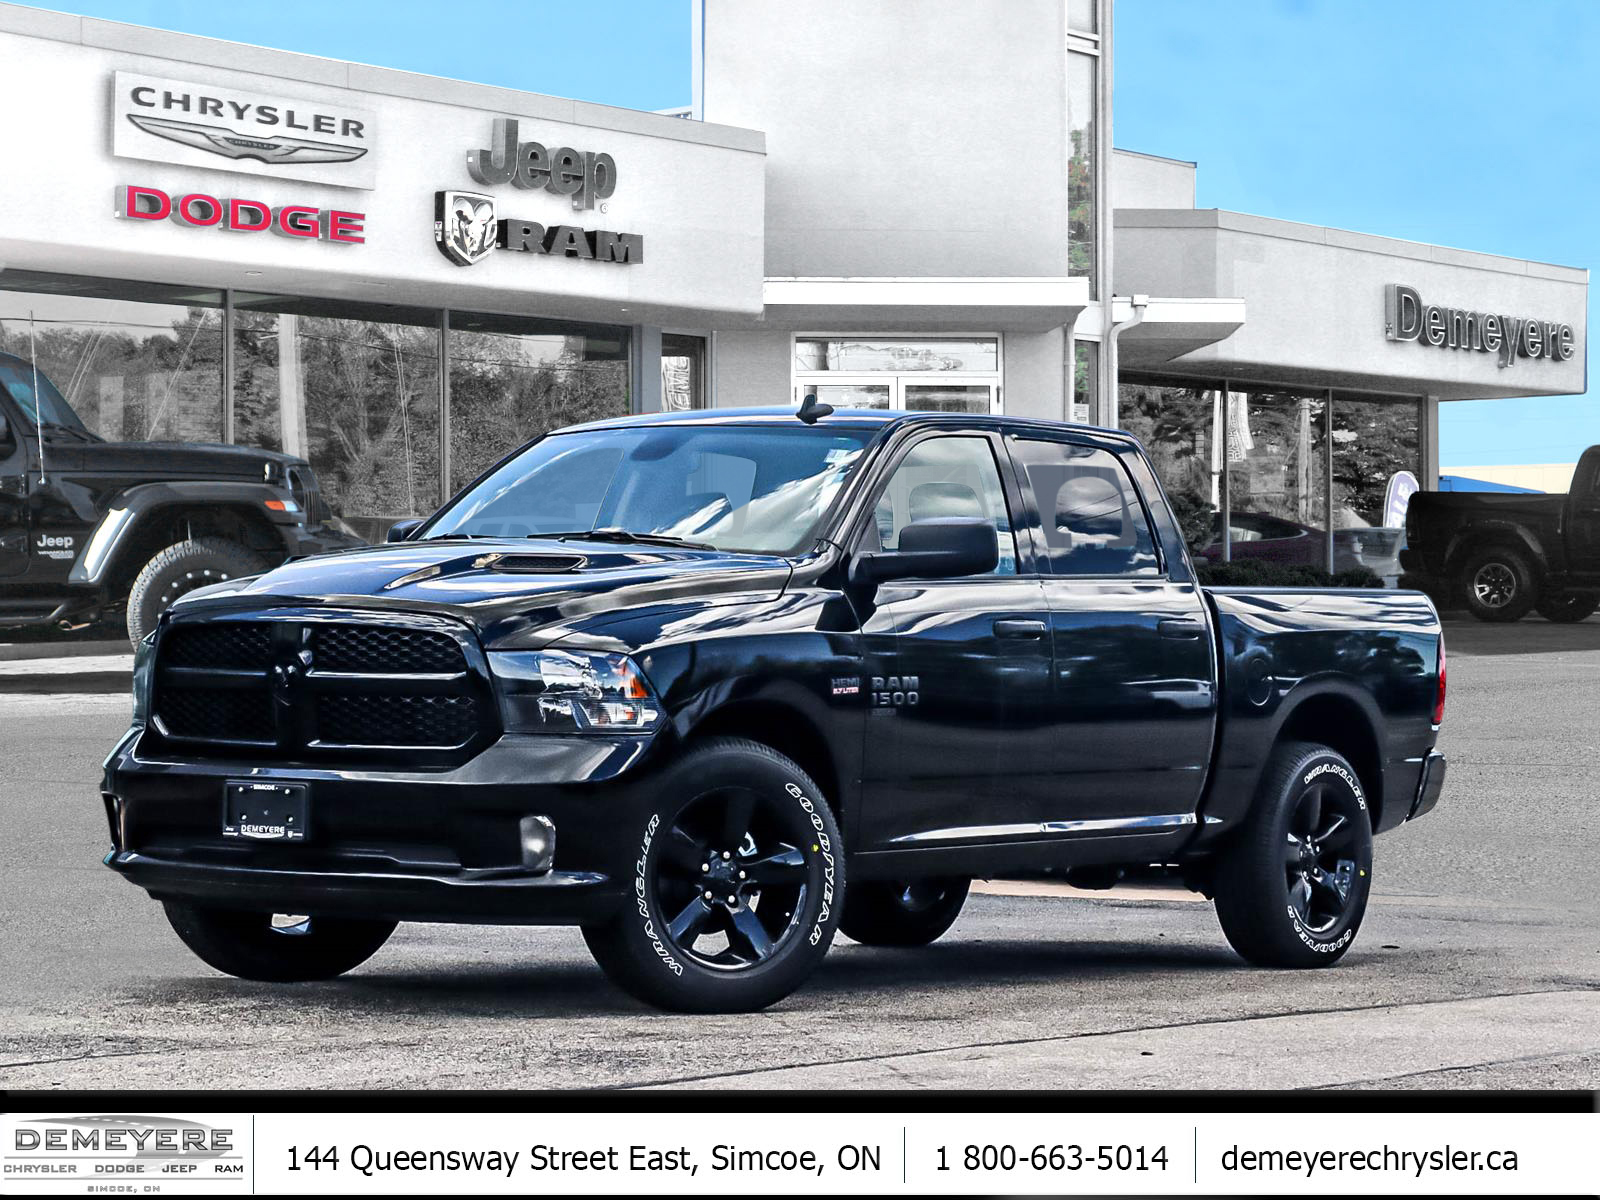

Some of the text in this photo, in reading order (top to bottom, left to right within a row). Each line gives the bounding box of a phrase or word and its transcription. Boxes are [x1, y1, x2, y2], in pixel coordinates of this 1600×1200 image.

[129, 86, 365, 140] CHRYSLER
[467, 118, 617, 210] Jeep
[115, 184, 366, 244] DODGE
[498, 218, 644, 264] RAM
[1385, 283, 1575, 368] Demeyere
[37, 534, 73, 548] Jeep
[831, 677, 860, 688] HEMI
[871, 675, 919, 689] RAM
[871, 691, 919, 705] 1500
[1303, 763, 1366, 810] WRANGLER
[240, 824, 285, 834] DEMEYERE
[785, 782, 835, 946] GOODYEAR
[635, 813, 684, 977] WRANGLER
[1286, 904, 1352, 953] GOODYEAR
